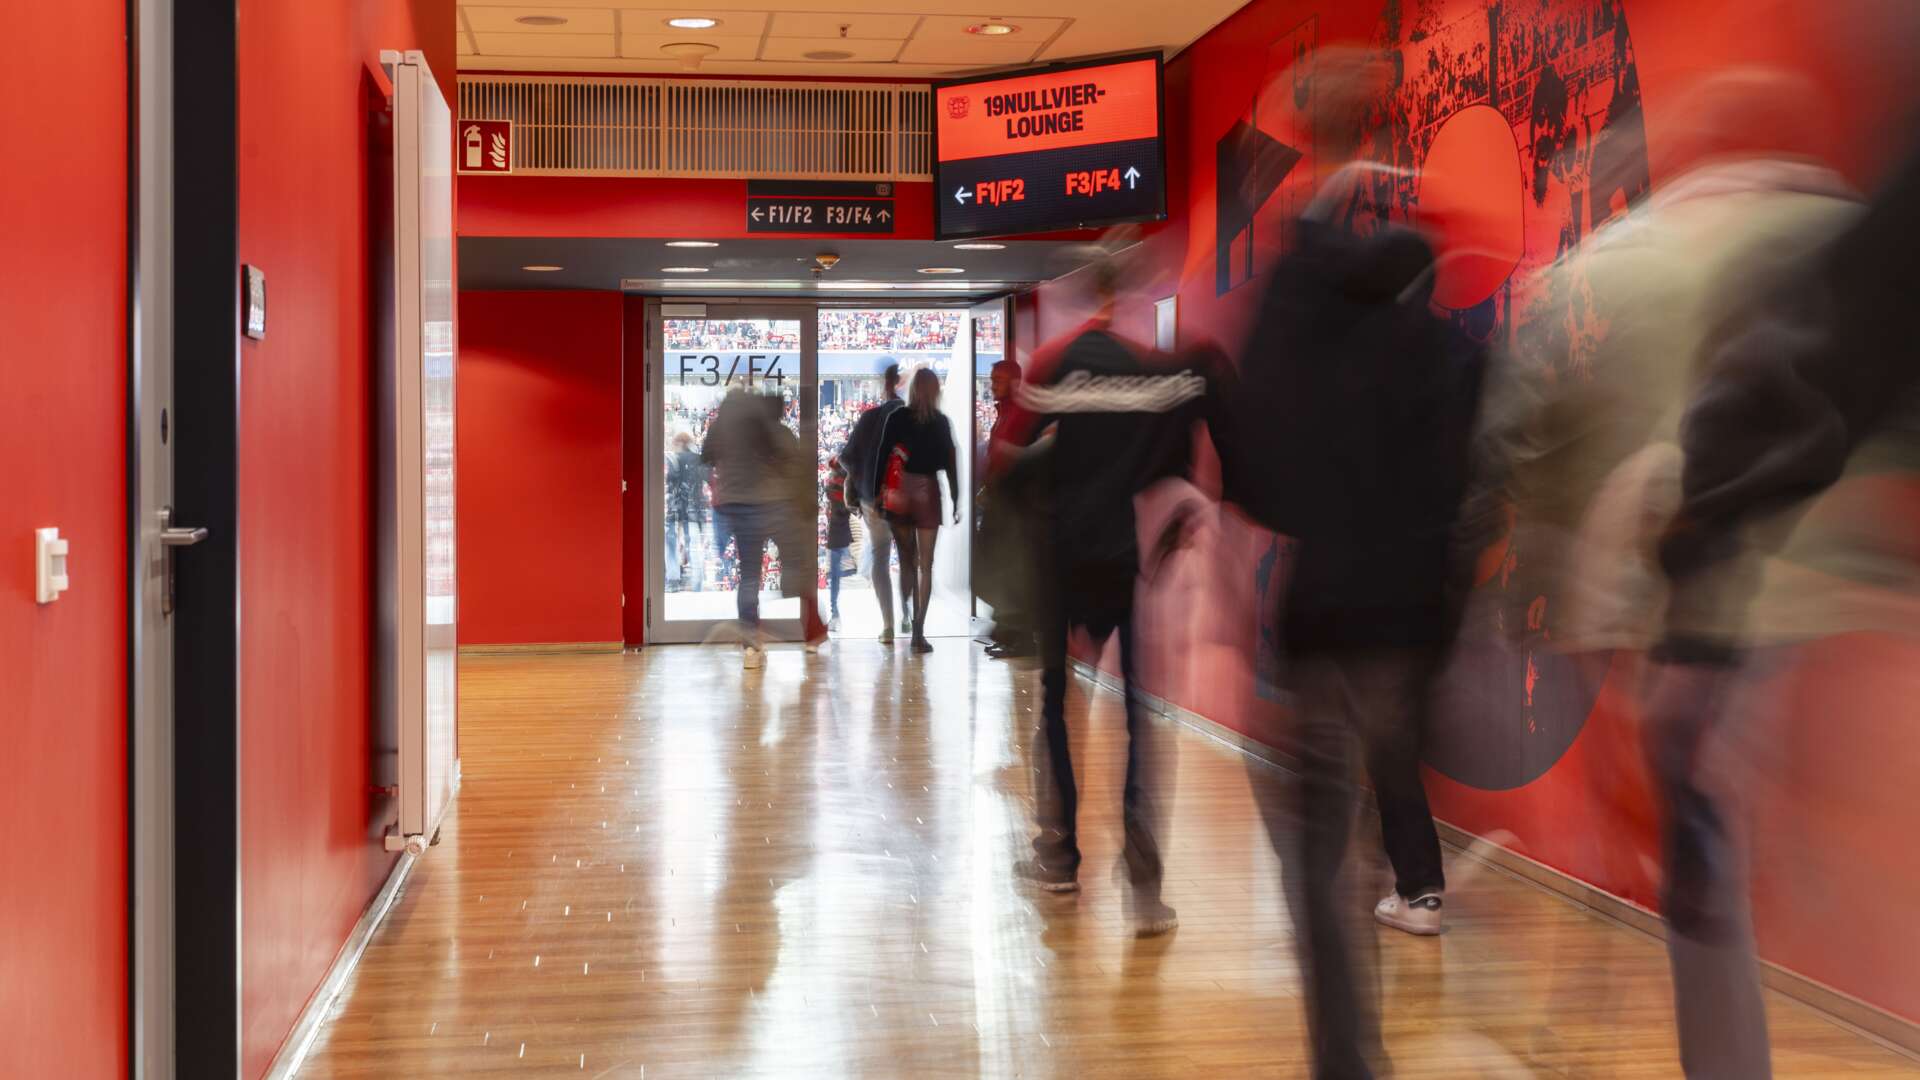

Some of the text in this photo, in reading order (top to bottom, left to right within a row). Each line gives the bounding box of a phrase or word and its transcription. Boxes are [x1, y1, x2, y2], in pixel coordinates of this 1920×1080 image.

[984, 83, 1106, 117] 19NULLVIER-
[1006, 110, 1084, 139] LOUNGE
[976, 178, 1025, 207] F1/F2
[1065, 168, 1121, 197] F3/F4
[769, 205, 872, 224] F1/F2 F3/F4
[680, 355, 786, 386] F3/F4
